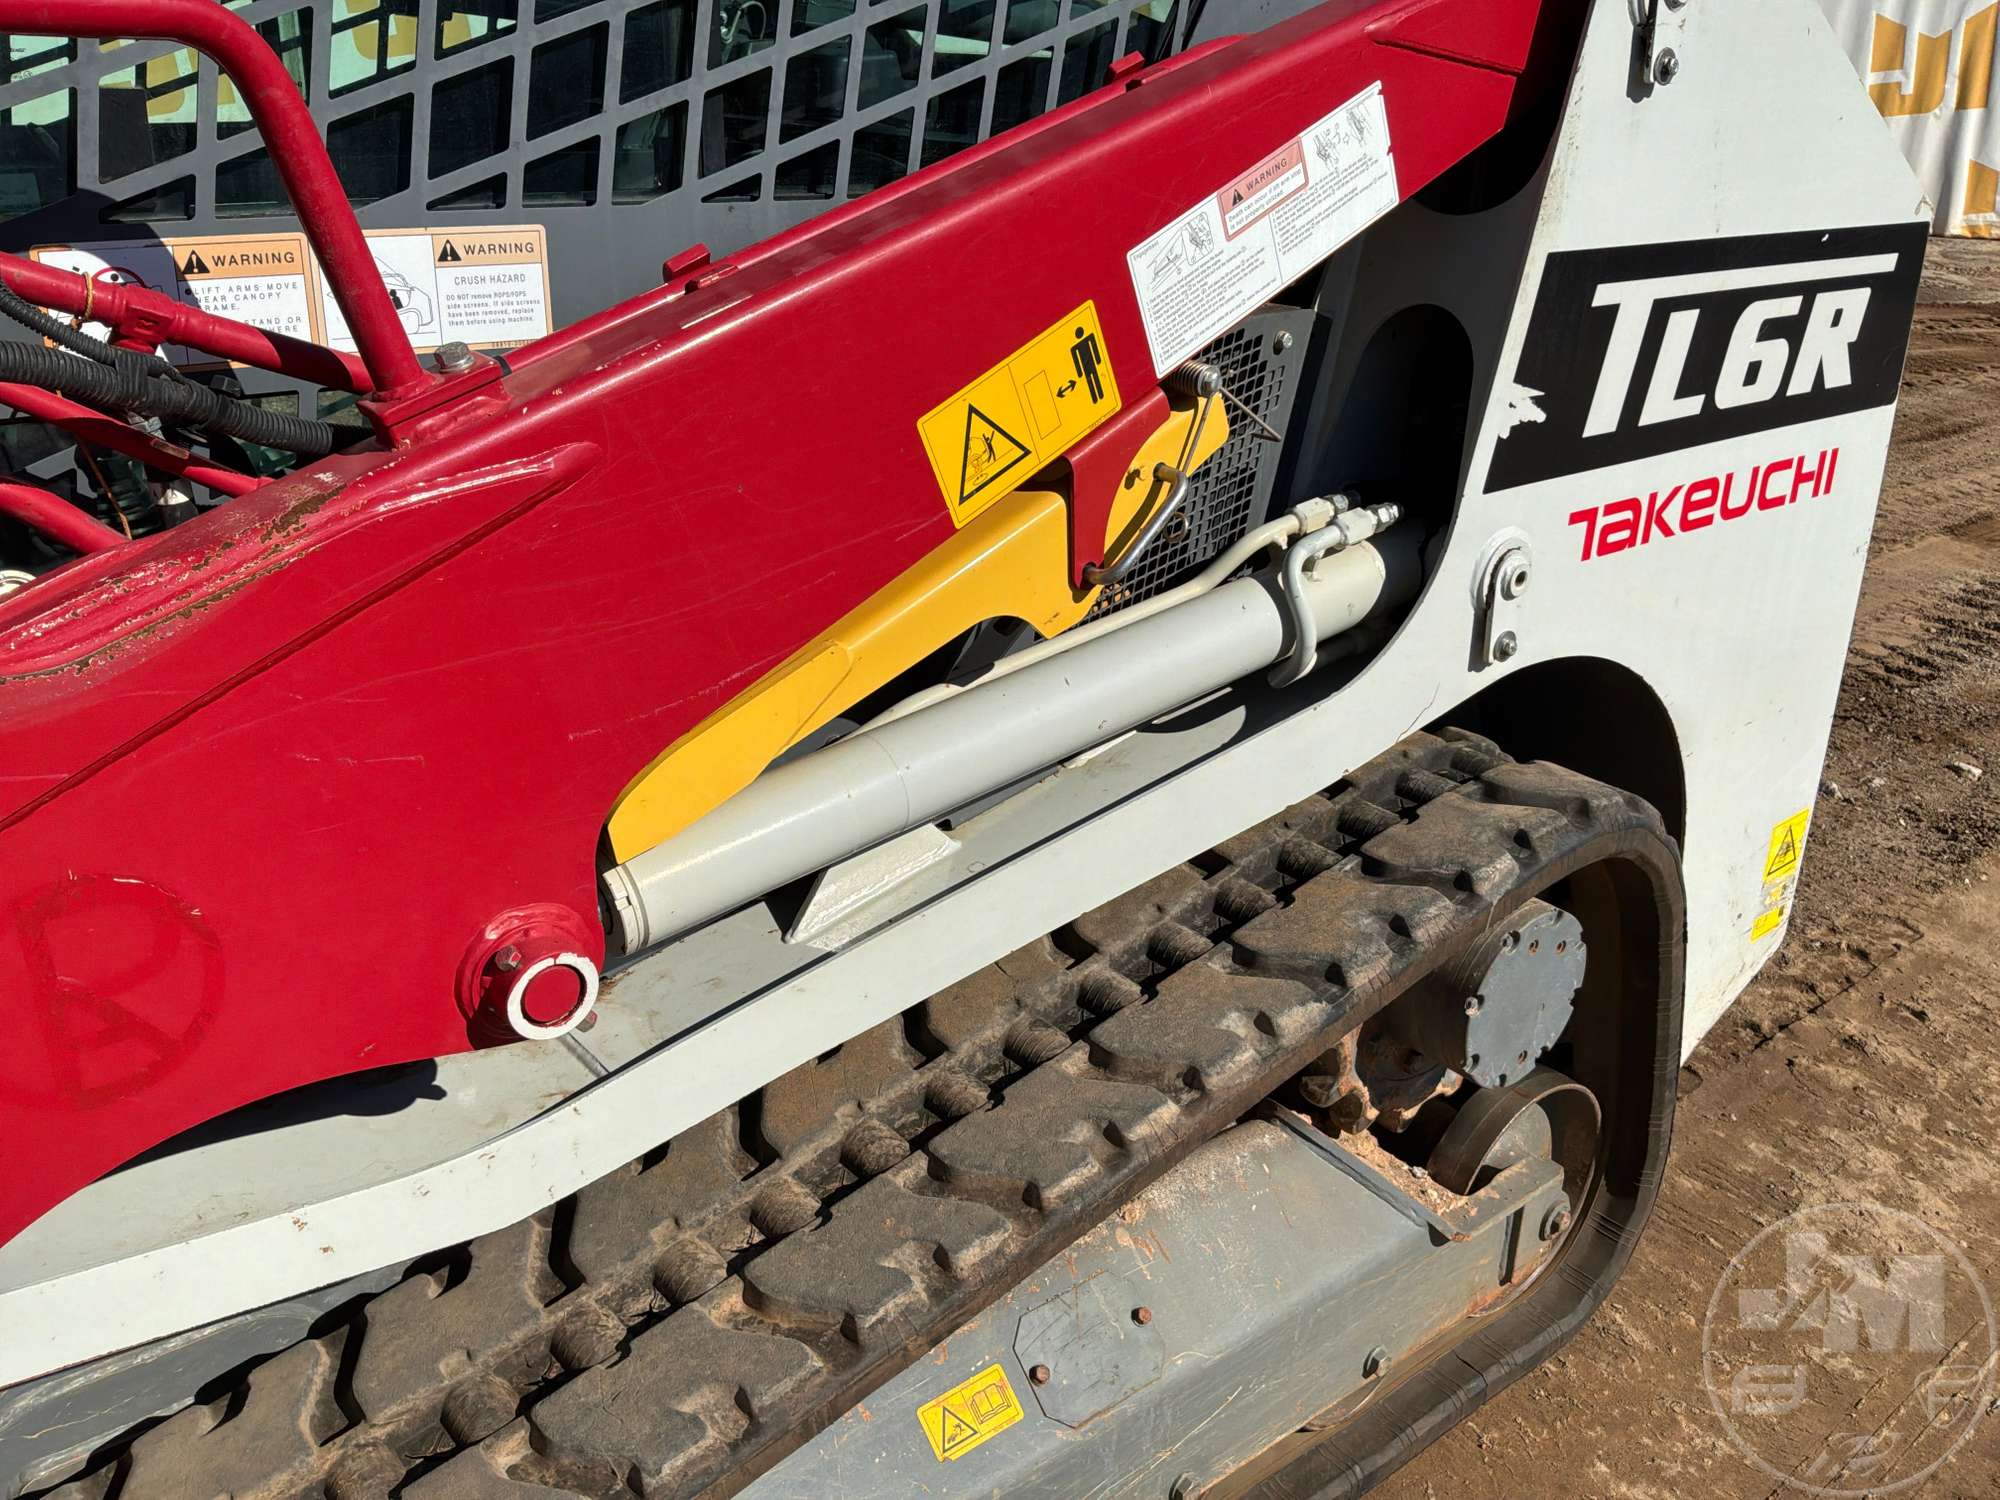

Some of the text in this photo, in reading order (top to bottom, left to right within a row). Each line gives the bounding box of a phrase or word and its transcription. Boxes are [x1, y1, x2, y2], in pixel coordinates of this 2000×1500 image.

[1246, 158, 1287, 191] WARNING
[463, 242, 535, 256] WARNING
[211, 251, 296, 267] WARNING
[454, 273, 527, 286] CRUSH HAZARD
[194, 281, 299, 296] LIFT ARMS MOVE
[234, 291, 282, 302] CANOPY
[446, 294, 456, 302] DO
[457, 293, 469, 301] NOT
[447, 302, 461, 310] side
[501, 299, 514, 307] side
[465, 310, 480, 318] been
[512, 307, 535, 316] replace
[287, 316, 302, 324] OR
[448, 319, 465, 327] them
[466, 318, 487, 326] before
[489, 317, 506, 325] using
[1582, 252, 1899, 438] TL6R
